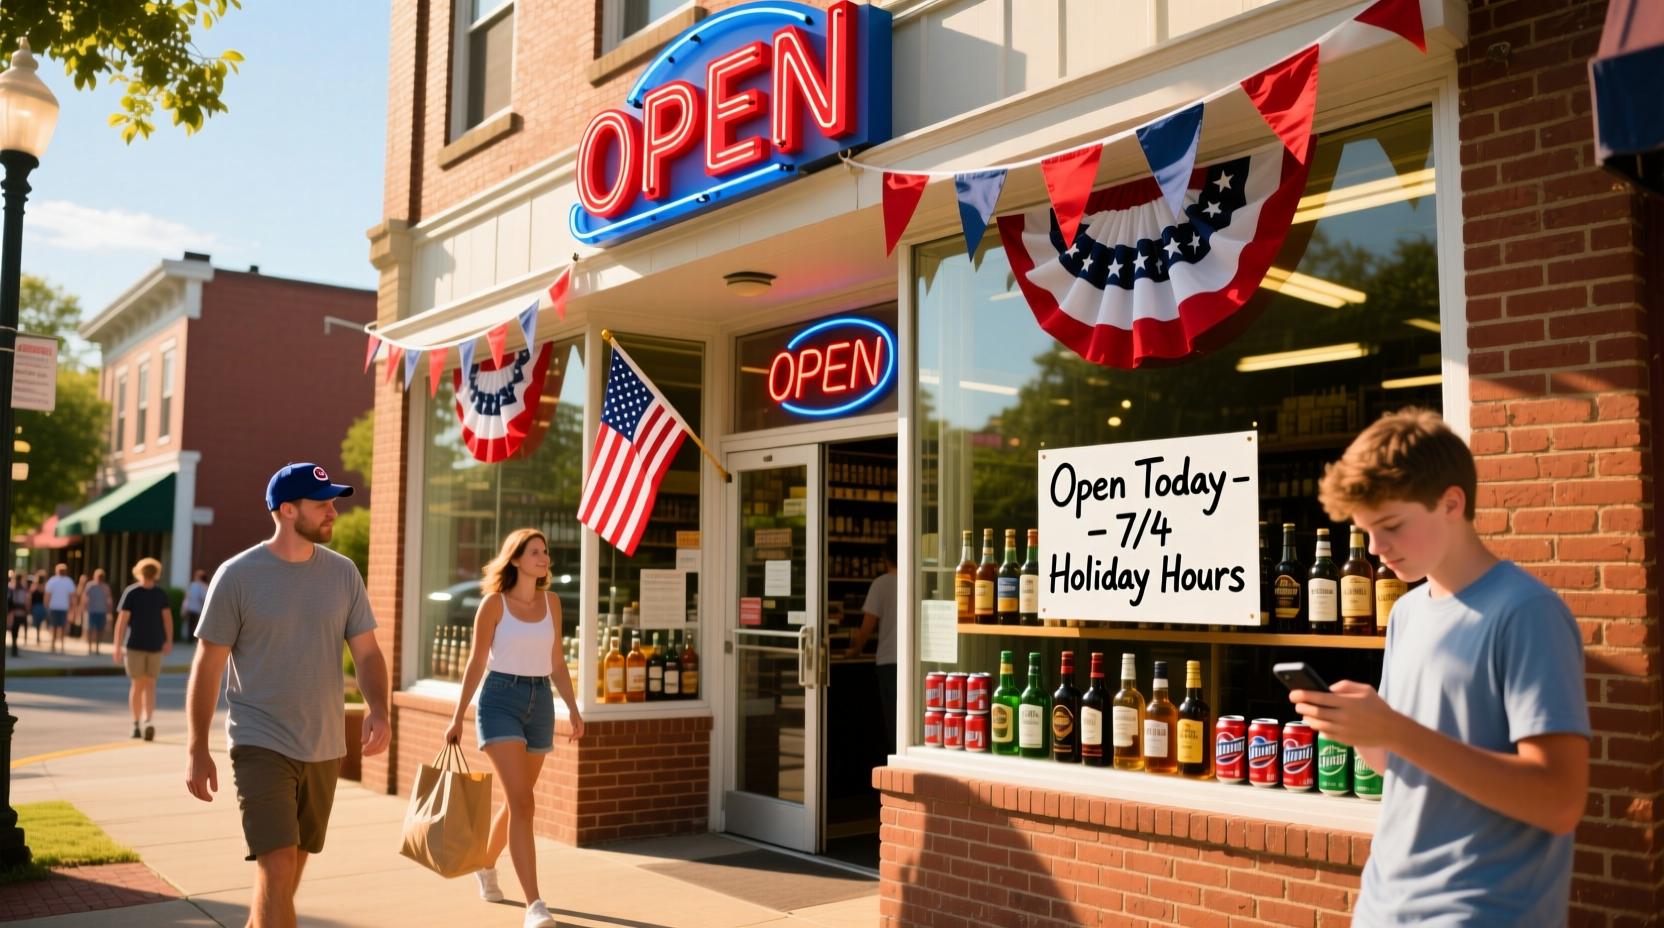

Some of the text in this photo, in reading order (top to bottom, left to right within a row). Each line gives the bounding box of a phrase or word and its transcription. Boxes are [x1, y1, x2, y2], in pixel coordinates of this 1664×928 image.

[576, 0, 859, 219] OPEN
[768, 336, 882, 401] OPEN
[1050, 462, 1125, 519] Open
[1050, 552, 1150, 607] Holiday
[1161, 553, 1245, 593] Hours
